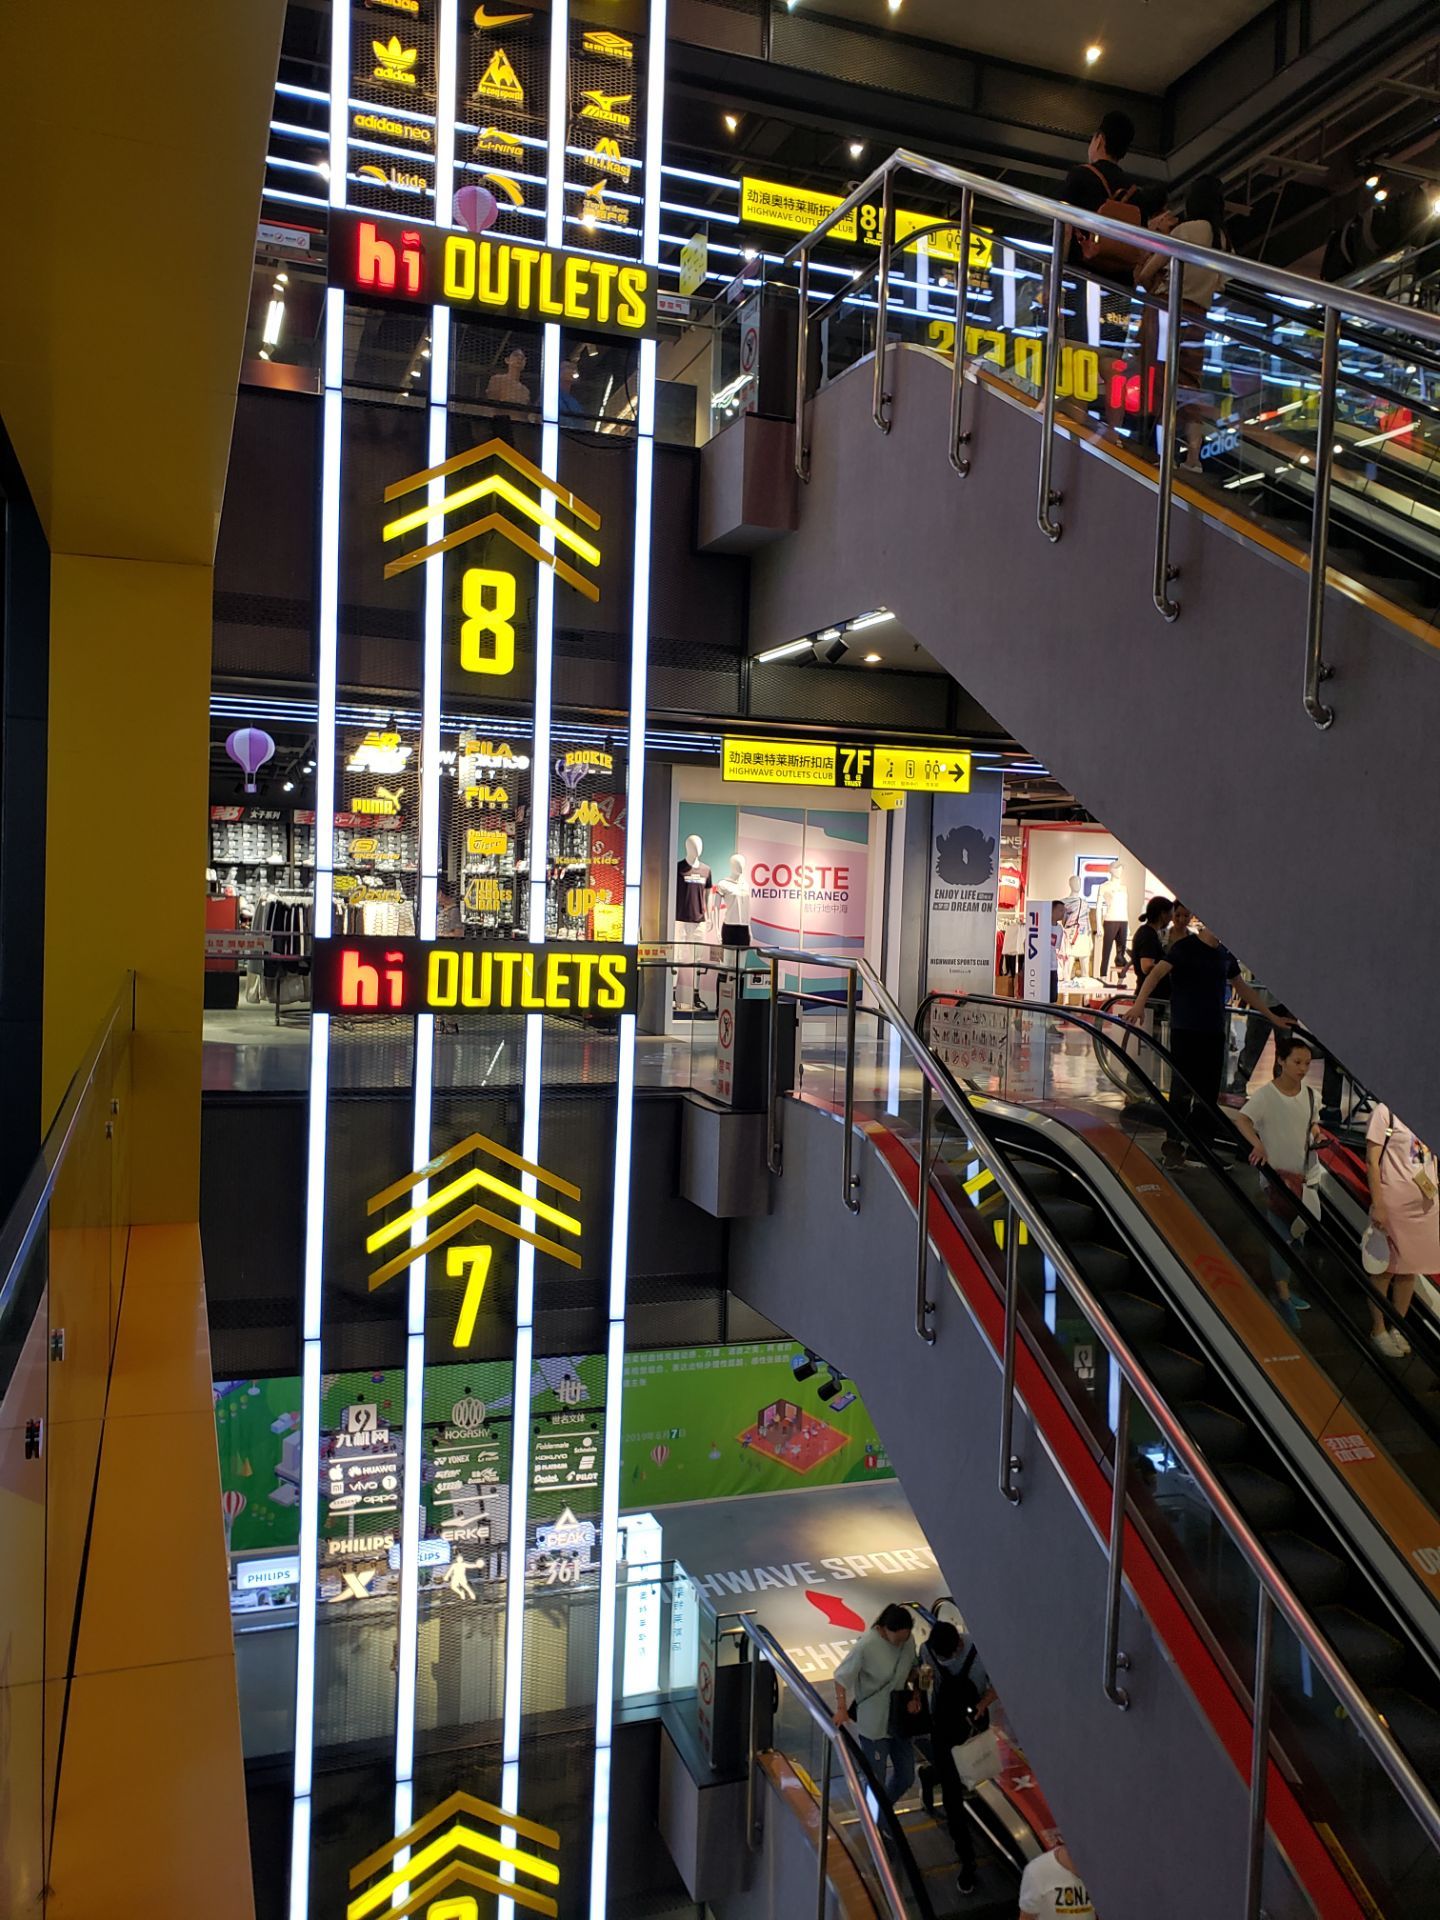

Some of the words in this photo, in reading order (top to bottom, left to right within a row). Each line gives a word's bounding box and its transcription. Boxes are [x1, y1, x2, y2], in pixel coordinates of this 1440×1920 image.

[374, 67, 416, 83] adidas
[354, 115, 403, 135] adidas
[404, 125, 431, 141] neo
[397, 172, 427, 189] kids
[747, 189, 856, 223] 劲浪奥特莱斯折店
[747, 205, 794, 222] HIGHWAVE
[356, 221, 424, 293] hi
[444, 235, 649, 329] OUTLETS
[461, 568, 516, 675] 8
[465, 740, 513, 758] FILA
[566, 750, 613, 769] ROOKIE
[729, 750, 834, 770] 劲浪奥特莱斯折扣店
[839, 748, 872, 775] 7F
[729, 766, 774, 777] HIGHWAVE
[775, 769, 812, 779] OUTLETS
[813, 771, 834, 780] CLUB
[465, 786, 508, 802] FILA
[750, 862, 850, 890] COSTE
[479, 889, 513, 901] SHOES
[750, 888, 850, 902] MEDITERRANEO
[933, 888, 960, 900] ENJOY
[960, 889, 977, 900] LIFE
[479, 899, 500, 910] BAR
[950, 901, 980, 912] DREAM
[981, 902, 994, 913] ON
[1028, 911, 1039, 961] FILA
[339, 949, 405, 1008] hi
[426, 949, 628, 1009] OUTLETS
[446, 1245, 492, 1348] 7
[335, 1428, 389, 1448] 九机网
[444, 1427, 491, 1440] HOGASHY
[447, 1453, 470, 1464] YONEX
[362, 1464, 397, 1475] HUAWEI
[575, 1472, 598, 1481] PILOT
[349, 1480, 379, 1491] vivo
[441, 1527, 489, 1541] ERKE
[328, 1533, 395, 1555] PHILIPS
[247, 1570, 291, 1583] PHILIPS
